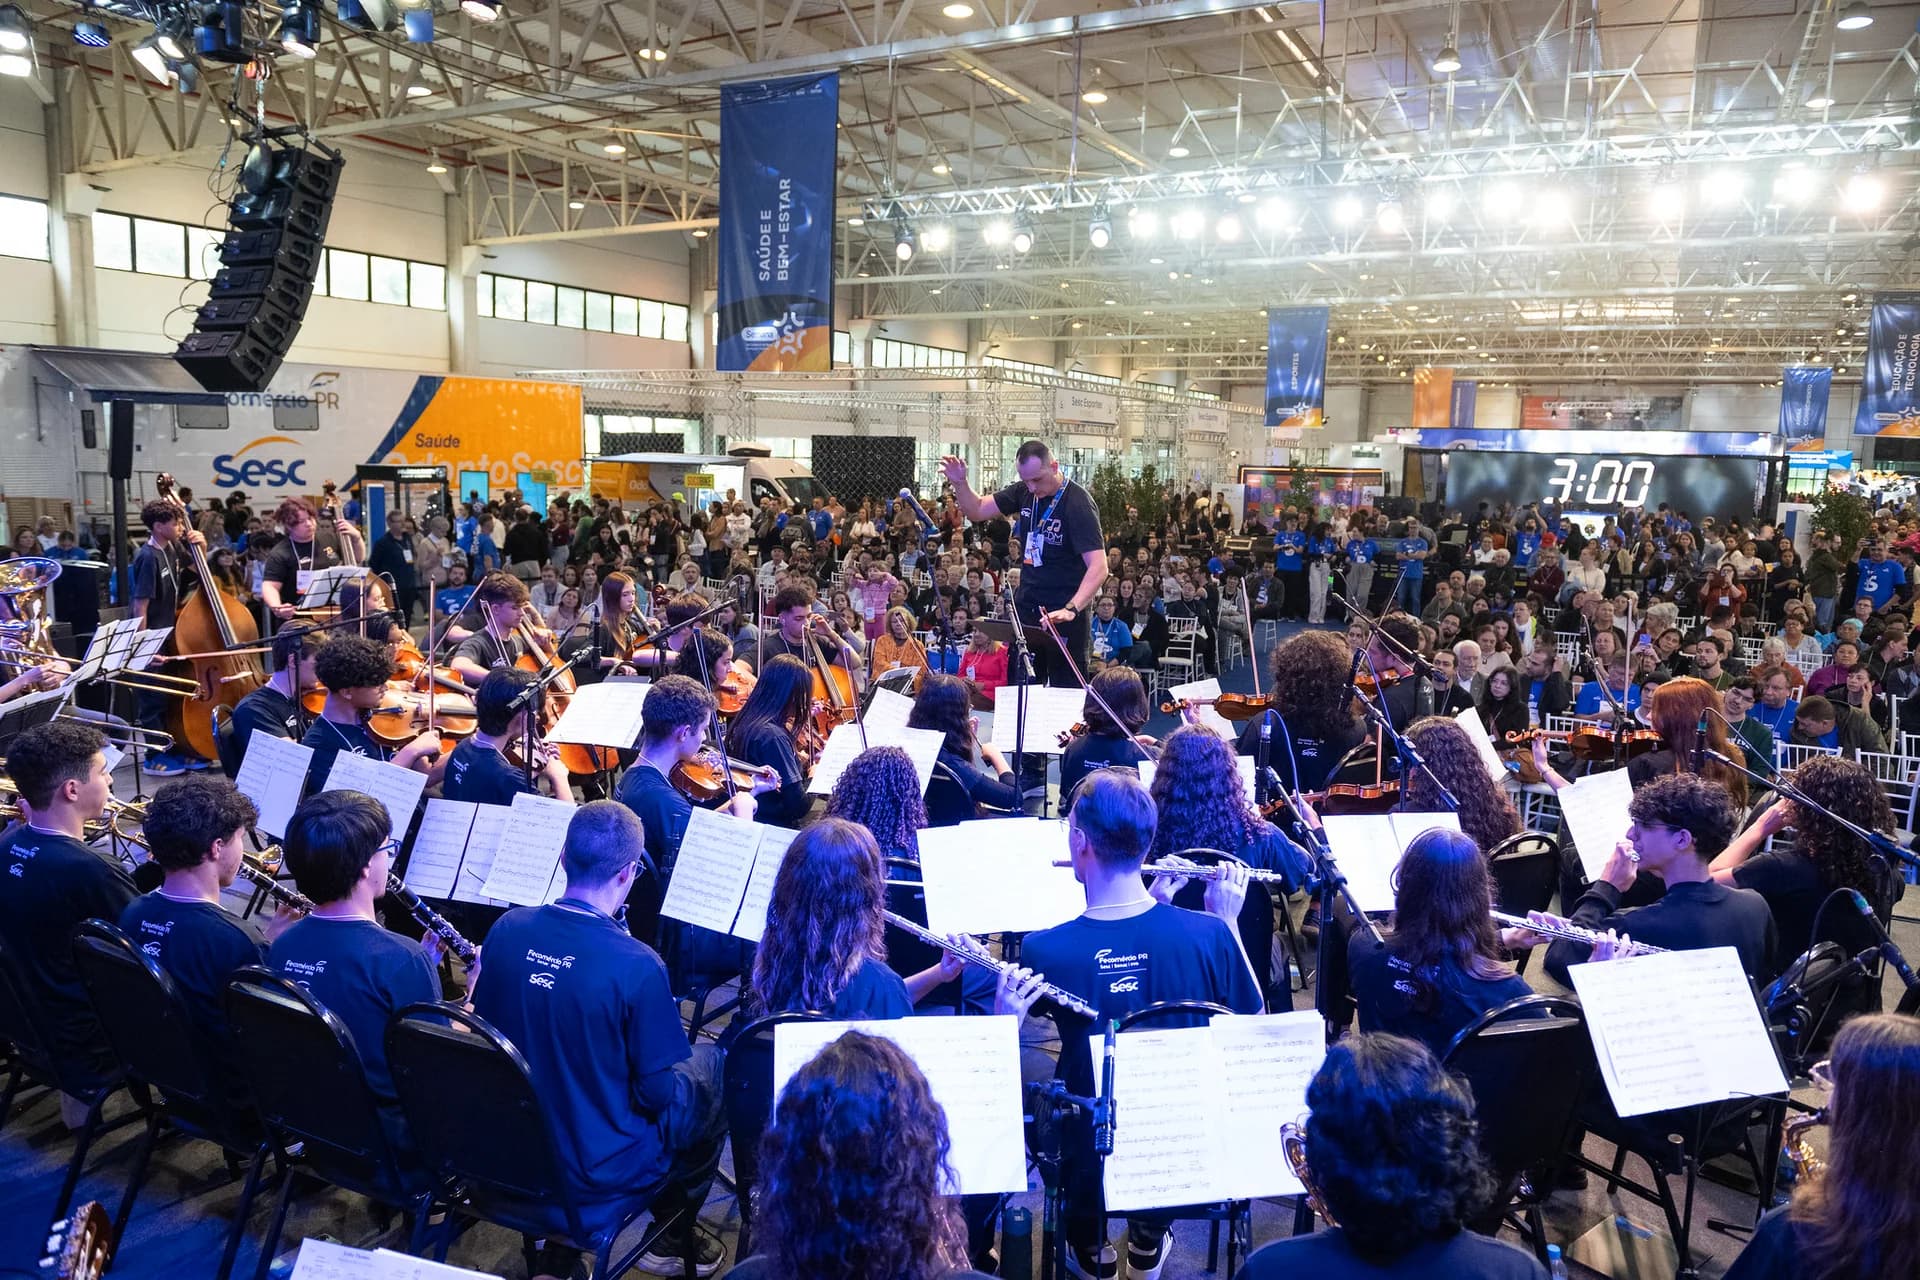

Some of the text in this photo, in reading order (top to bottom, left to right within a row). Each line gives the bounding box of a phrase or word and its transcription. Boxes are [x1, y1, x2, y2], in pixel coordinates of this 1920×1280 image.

[756, 209, 772, 281] SAÚDE E
[778, 178, 791, 281] BEM-ESTAR
[1291, 352, 1300, 390] ESPORTES
[1892, 341, 1907, 391] EDUCAÇÃO
[1904, 333, 1920, 391] TECNOLOGIA
[315, 391, 340, 410] PR
[415, 433, 460, 449] Saúde
[212, 454, 307, 488] Sesc
[1542, 458, 1655, 508] 3:00
[529, 973, 555, 990] Sesc
[1110, 980, 1139, 993] Sesc
